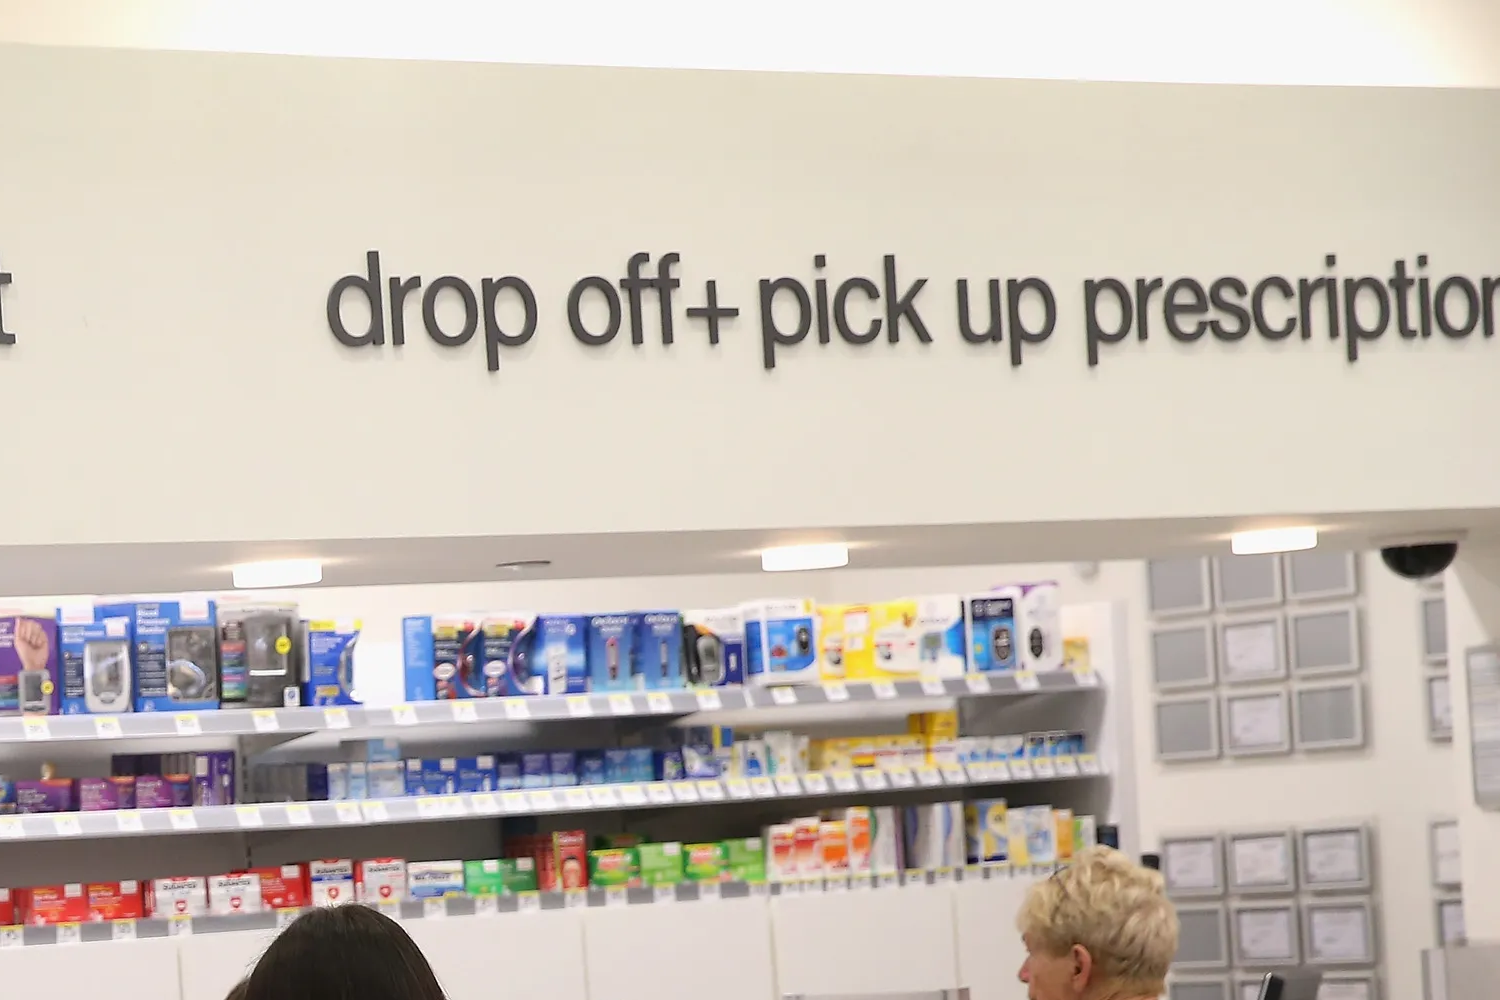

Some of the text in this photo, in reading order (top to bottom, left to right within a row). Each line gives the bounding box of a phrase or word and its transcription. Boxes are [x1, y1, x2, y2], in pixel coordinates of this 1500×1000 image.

[326, 250, 538, 372] drop
[758, 254, 933, 370] pick
[956, 277, 1057, 367] up
